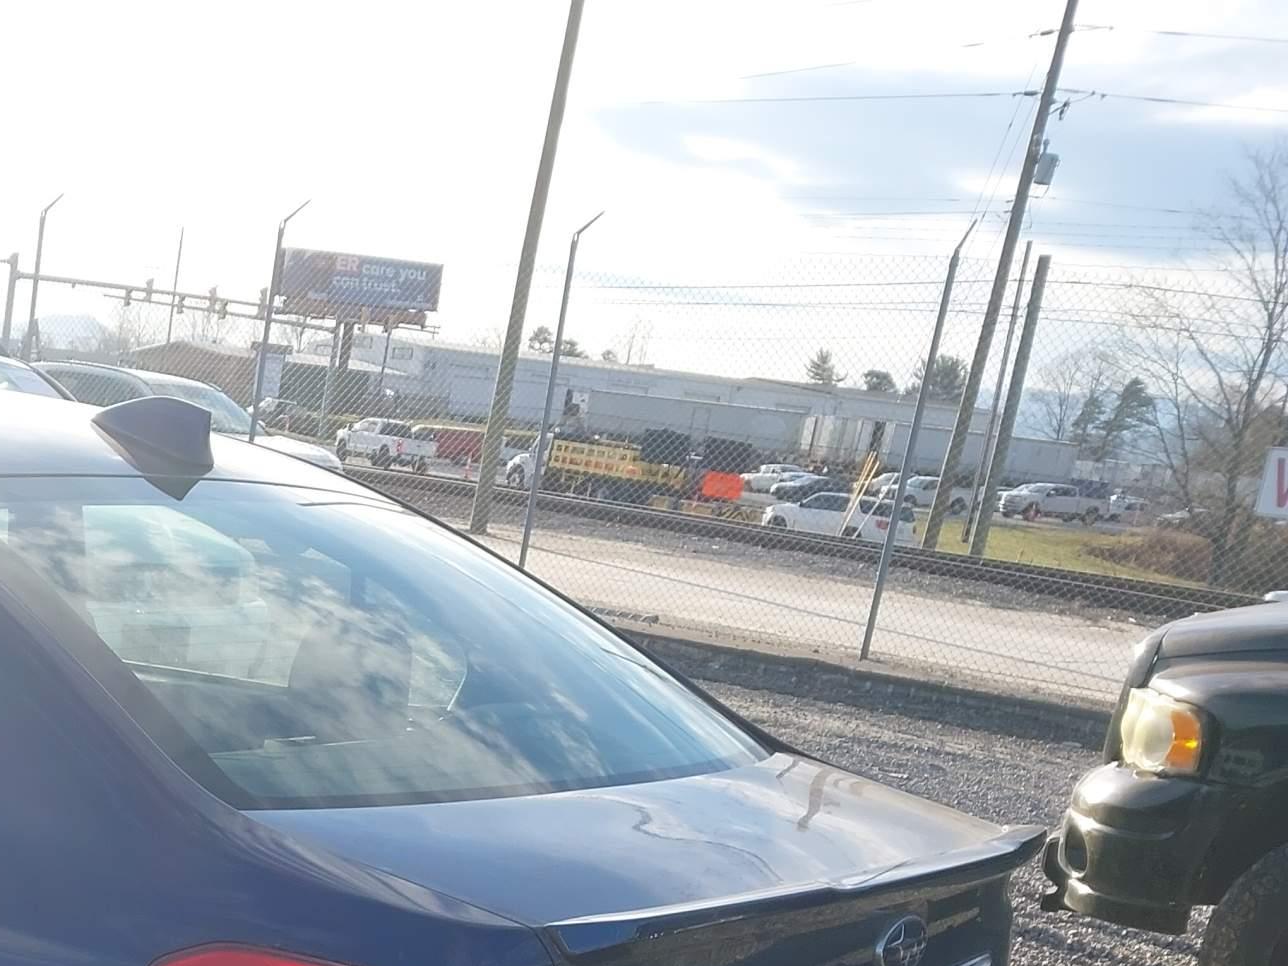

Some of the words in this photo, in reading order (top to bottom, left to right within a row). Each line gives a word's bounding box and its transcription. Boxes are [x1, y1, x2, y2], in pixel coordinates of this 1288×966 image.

[335, 255, 360, 271] ER
[362, 263, 395, 277] care
[399, 267, 427, 283] you
[332, 275, 359, 289] can
[362, 277, 401, 292] trust.
